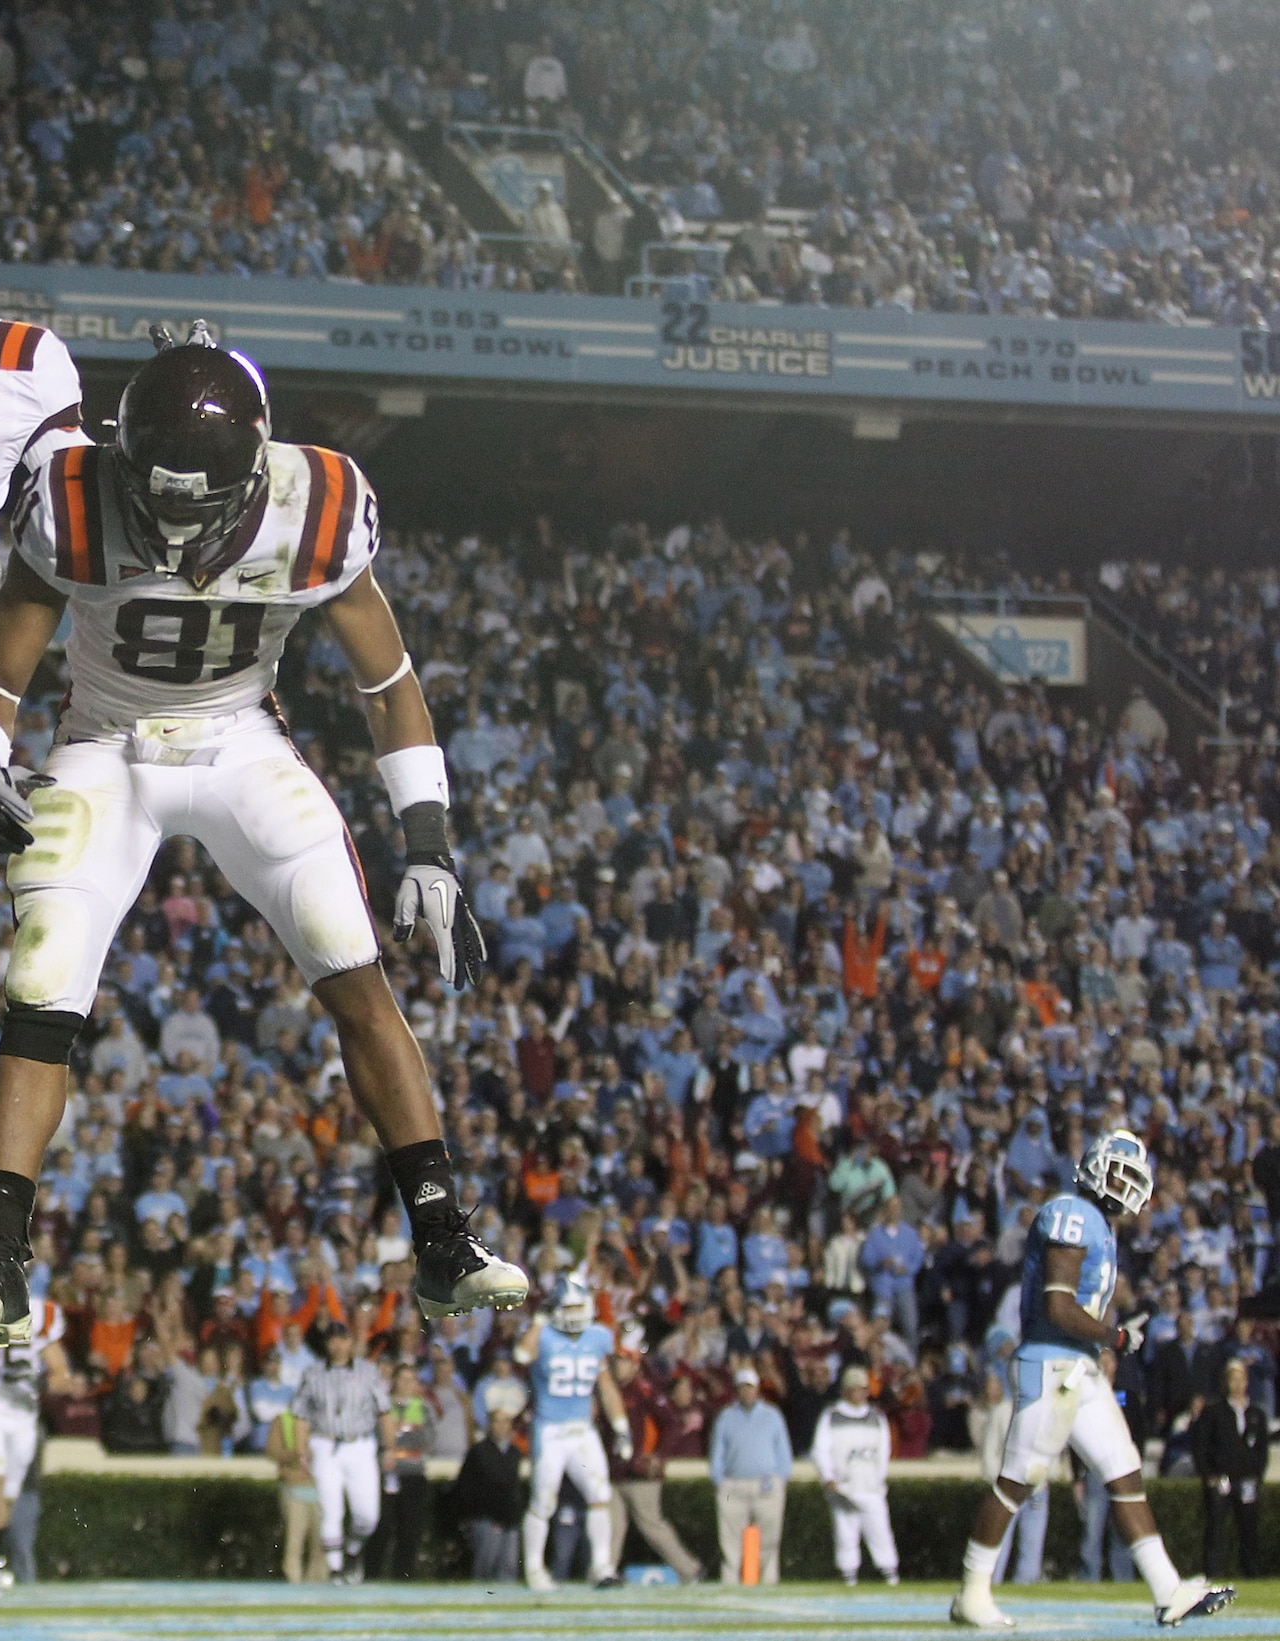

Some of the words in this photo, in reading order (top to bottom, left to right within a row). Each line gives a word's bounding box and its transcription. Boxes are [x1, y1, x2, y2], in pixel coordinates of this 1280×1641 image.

[662, 302, 709, 346] 22
[709, 326, 831, 350] CHARLIE
[329, 328, 455, 351] GATOR
[472, 335, 572, 358] BOWL
[663, 346, 832, 377] JUSTICE
[914, 356, 1032, 380] PEACH
[1050, 363, 1149, 386] BOWL
[112, 598, 267, 684] 81
[1049, 1211, 1085, 1244] 16
[548, 1355, 600, 1397] 25
